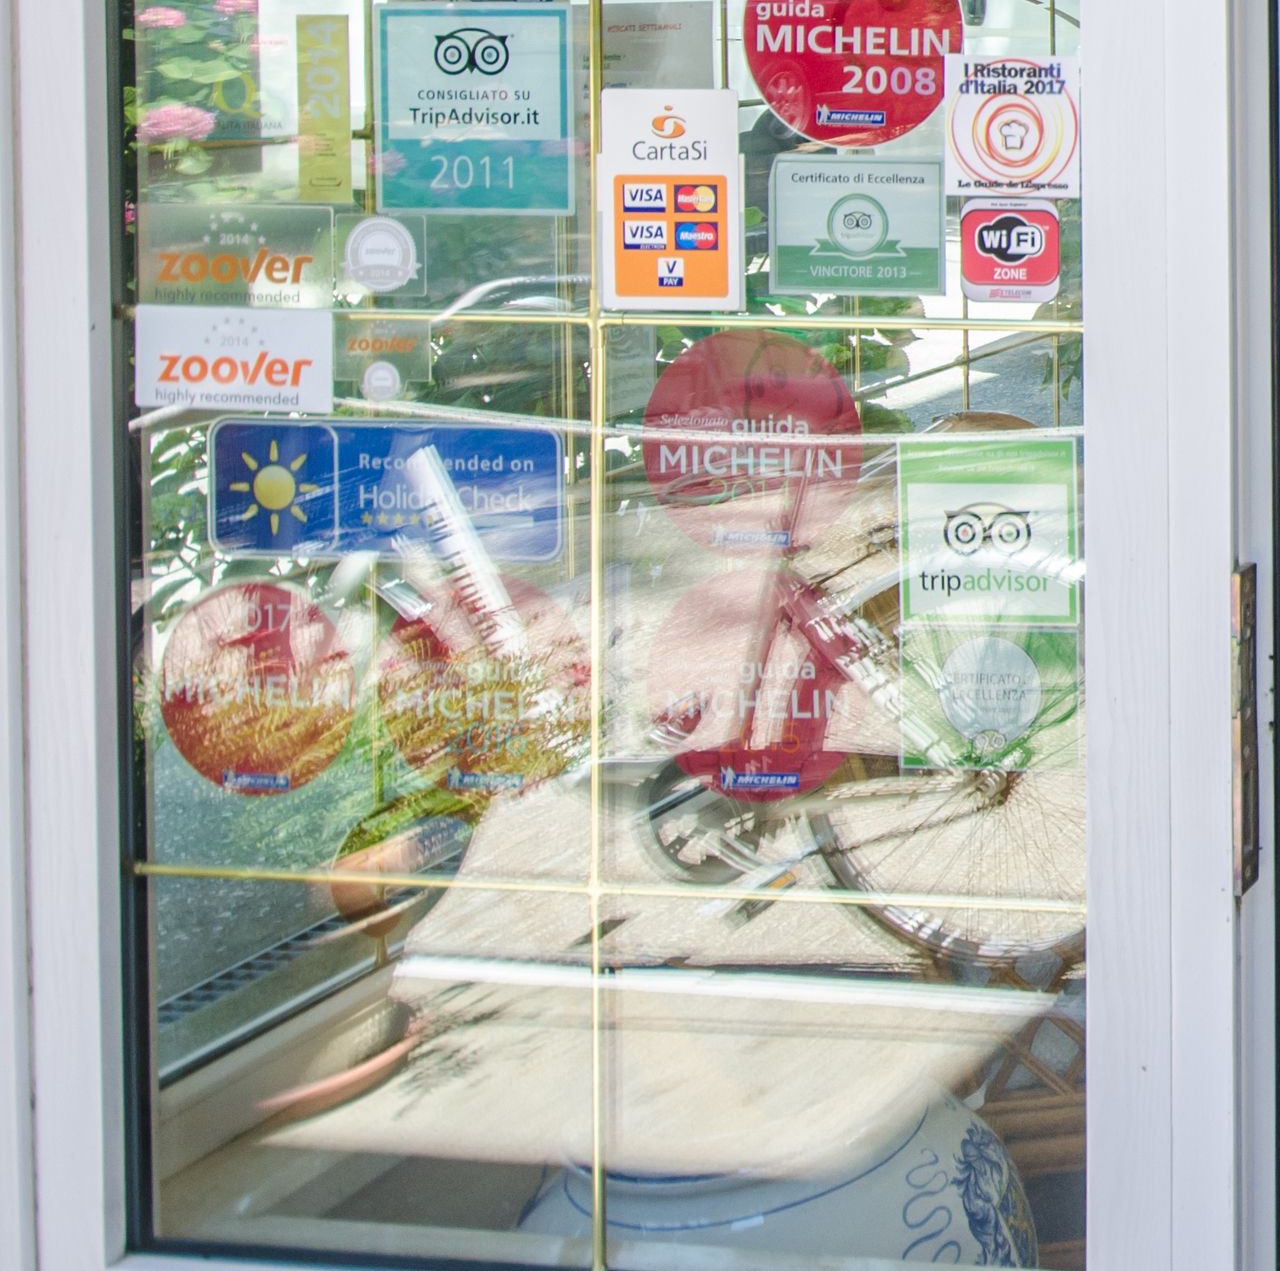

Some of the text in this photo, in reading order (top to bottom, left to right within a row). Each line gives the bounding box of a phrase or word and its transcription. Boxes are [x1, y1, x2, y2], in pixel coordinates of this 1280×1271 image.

[755, 24, 950, 56] MICHELIN
[963, 63, 1061, 78] I Ristoranti
[842, 65, 937, 95] 2008
[959, 79, 1066, 95] d'Italia 2017
[417, 89, 531, 101] CONSIGLIATO SU
[409, 106, 540, 128] TripAdvisor.it
[830, 112, 884, 123] MICHELIN
[632, 140, 707, 161] CartaSi
[430, 155, 516, 190] 2011
[791, 172, 926, 185] Certificato di Eccellenza
[957, 179, 971, 188] Le
[973, 180, 1004, 189] Guide
[1006, 180, 1019, 189] de
[629, 188, 664, 202] VISA
[219, 233, 250, 246] 2014
[629, 225, 664, 239] VISA
[679, 231, 714, 240] Maestro
[157, 247, 314, 285] zoover
[665, 260, 677, 274] V
[810, 265, 907, 279] VINCITORE 2013
[993, 268, 1027, 280] ZONE
[663, 277, 679, 285] PAY
[154, 287, 300, 304] highly recommended
[219, 336, 249, 347] 2014
[346, 334, 418, 354] zoover
[157, 351, 313, 388] zoover
[154, 388, 300, 406] highly recommended
[659, 413, 729, 427] Selezionato
[358, 453, 535, 473] Recoended on
[659, 444, 843, 478] MICHELIN
[358, 484, 535, 513] HolidCheck
[919, 568, 1051, 597] tripadvisor
[738, 659, 816, 684] guda
[396, 688, 577, 721] MICHELN
[736, 775, 797, 785] MICHELIN
